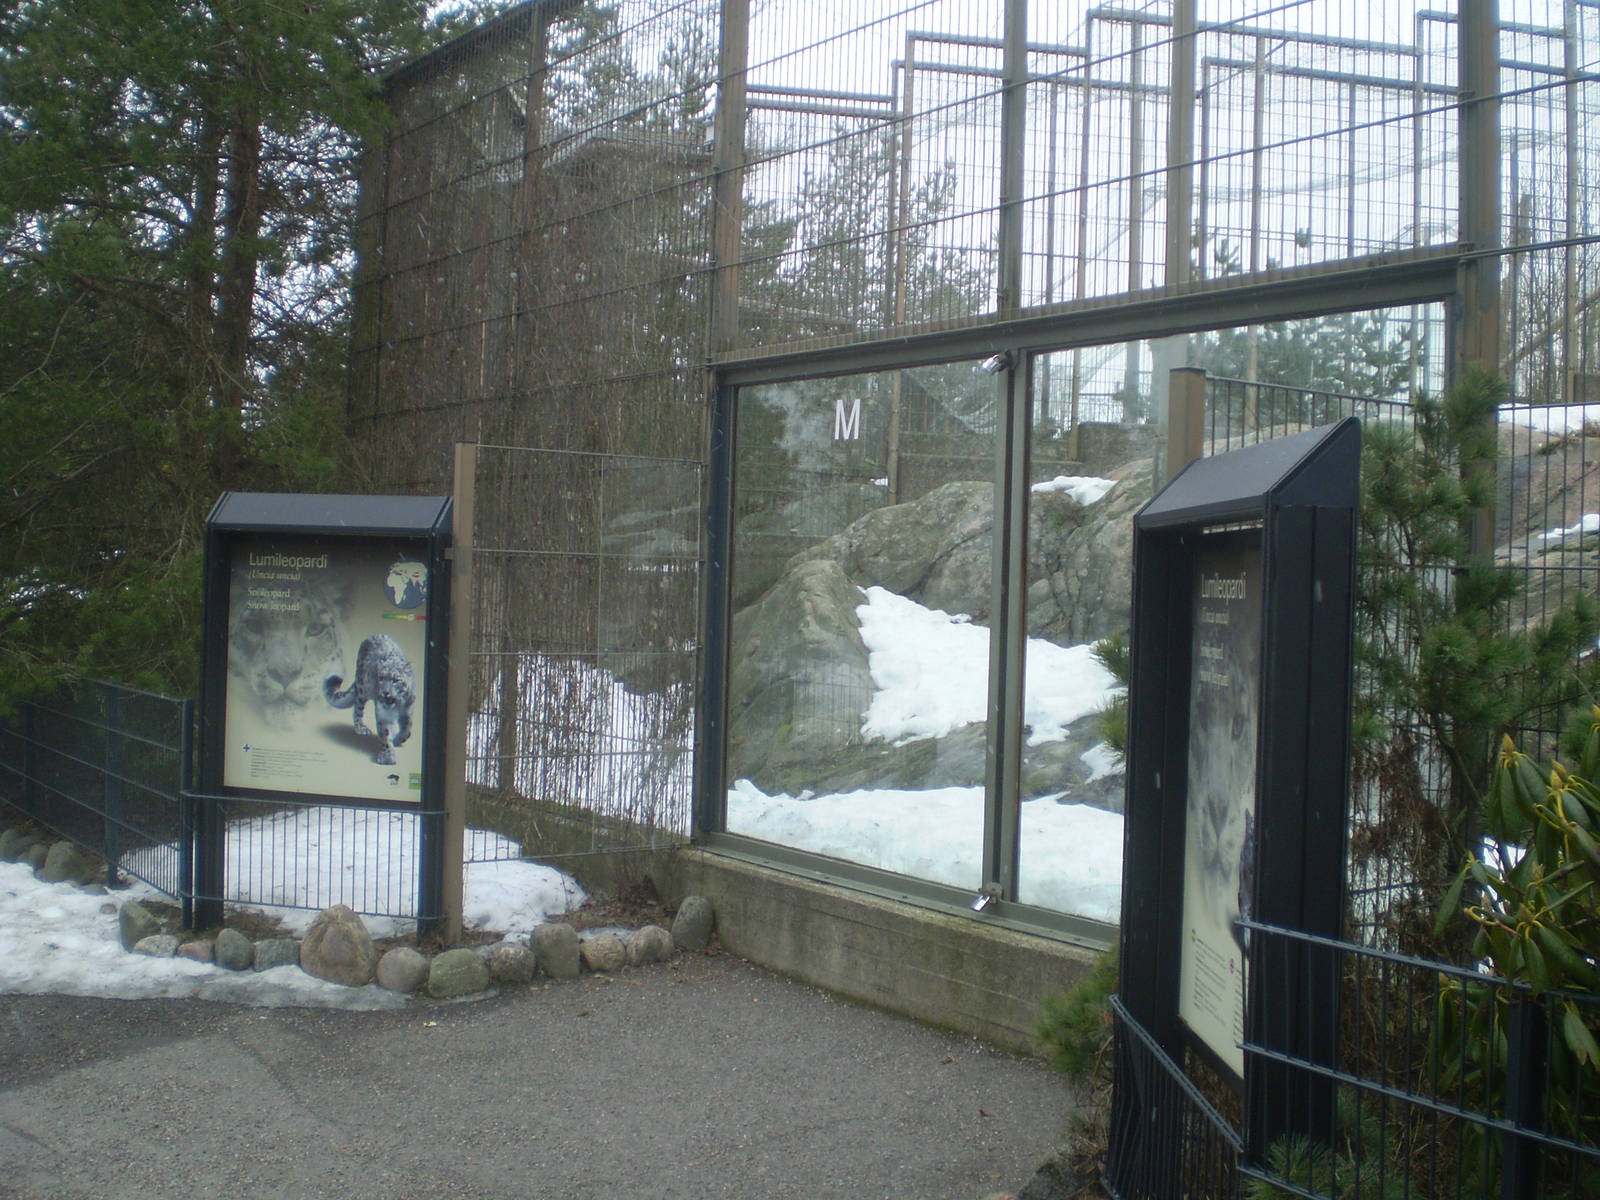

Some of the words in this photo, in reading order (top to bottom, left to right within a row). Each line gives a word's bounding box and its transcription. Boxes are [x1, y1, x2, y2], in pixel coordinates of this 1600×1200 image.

[834, 398, 861, 440] M
[249, 552, 328, 571] Lumileopardi
[1201, 571, 1247, 605] Lumileopardi
